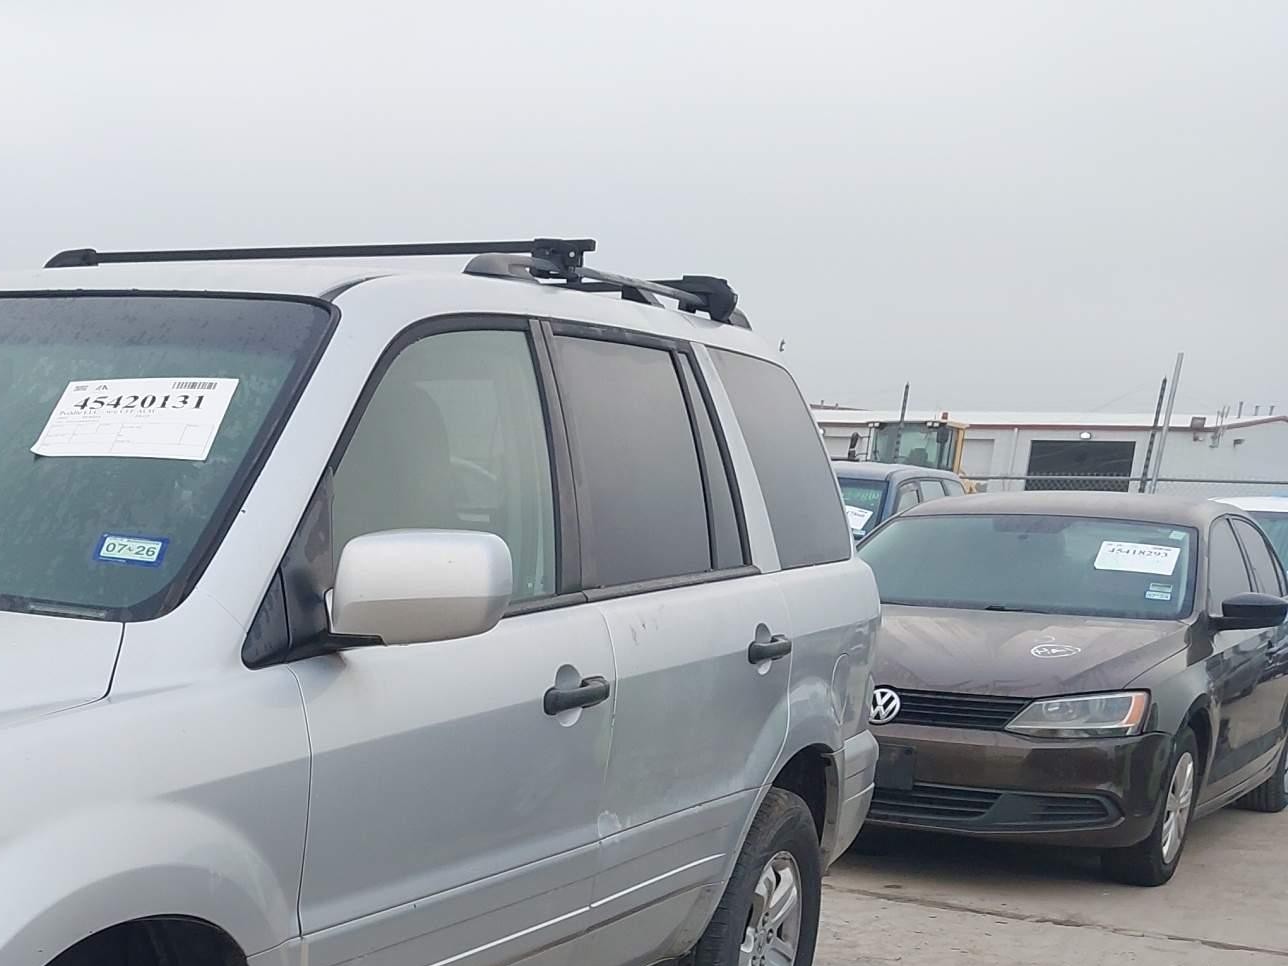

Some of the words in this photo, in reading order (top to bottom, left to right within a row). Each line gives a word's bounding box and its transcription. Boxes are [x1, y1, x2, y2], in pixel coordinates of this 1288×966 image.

[73, 395, 204, 410] 45420131
[105, 542, 128, 554] 07
[134, 545, 157, 557] 26
